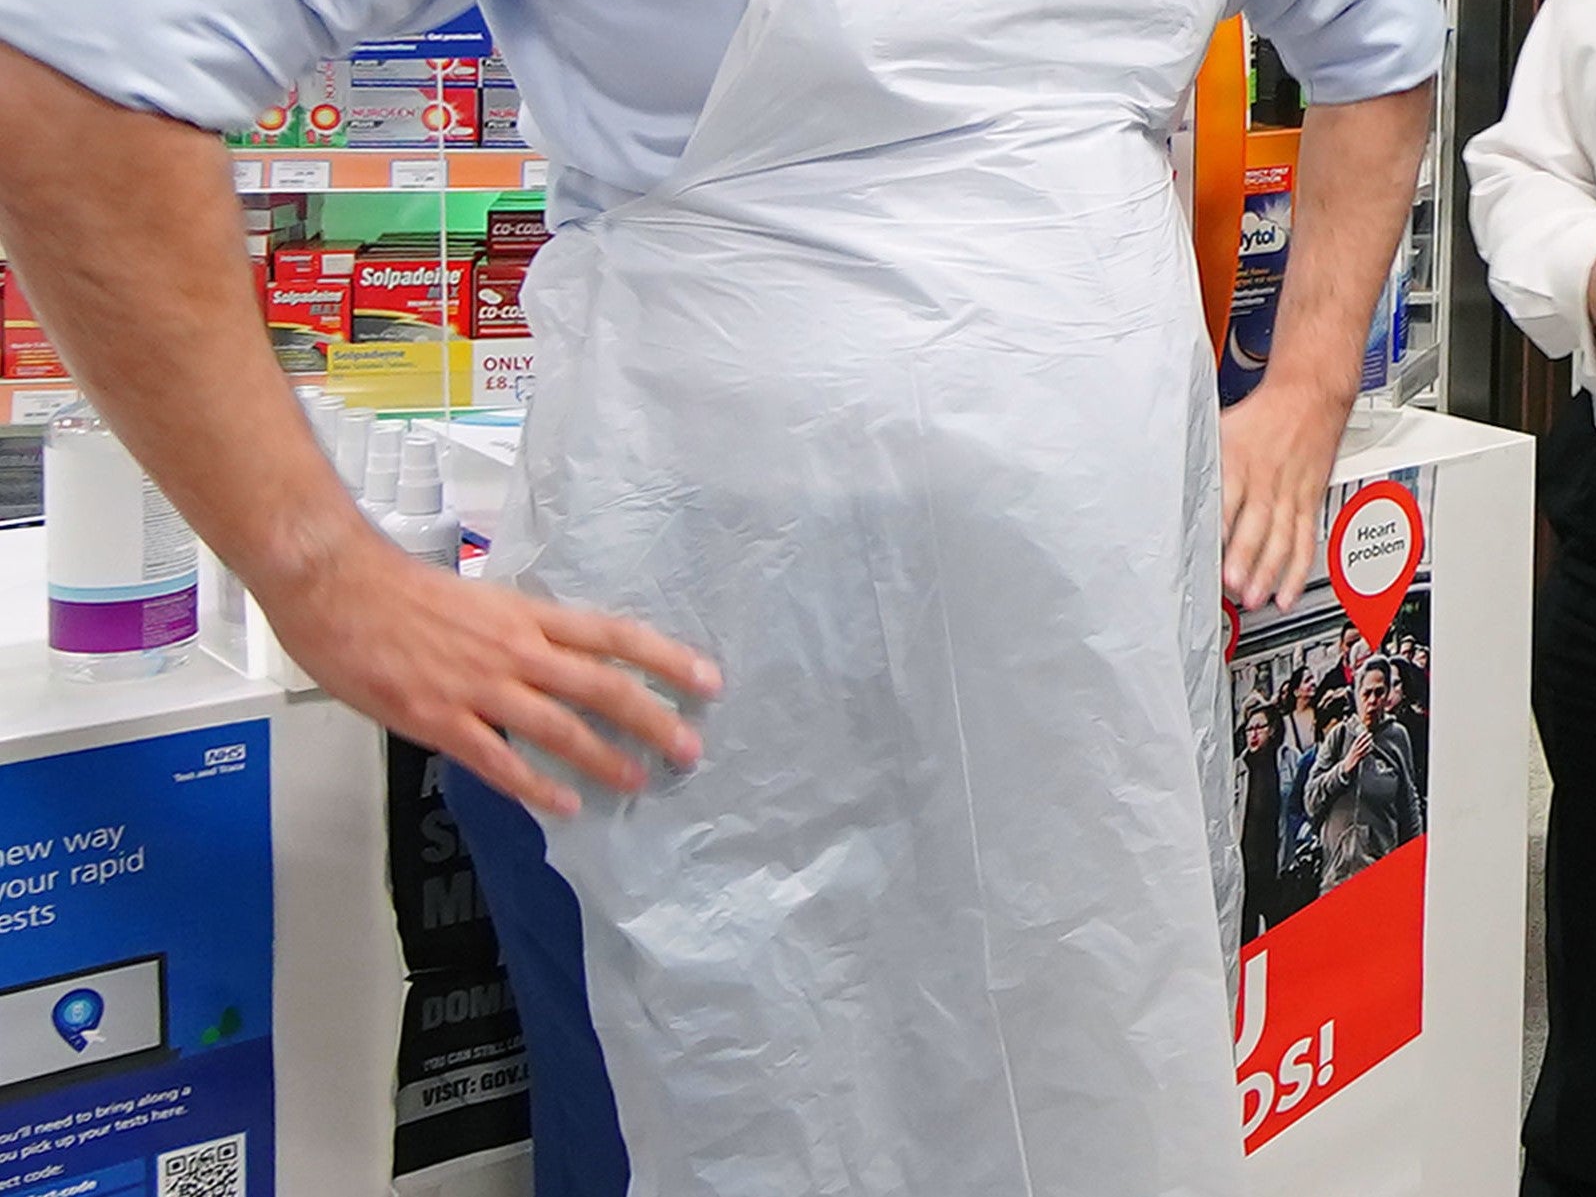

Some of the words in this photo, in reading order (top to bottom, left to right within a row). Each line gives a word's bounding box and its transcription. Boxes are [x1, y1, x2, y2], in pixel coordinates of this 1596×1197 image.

[352, 107, 416, 118] NUROFEN
[272, 290, 343, 306] Solpadeine
[484, 356, 533, 371] ONLY
[1357, 520, 1397, 542] Heart
[1347, 538, 1406, 568] problem
[0, 838, 53, 869] ew
[62, 823, 126, 852] way
[70, 845, 145, 885] rapid
[422, 1077, 477, 1107] VISIT:
[34, 1113, 74, 1135] need
[76, 1110, 94, 1124] to
[95, 1097, 136, 1119] bring
[137, 1088, 179, 1108] along
[181, 1085, 193, 1097] a
[20, 1139, 52, 1160] pick
[54, 1134, 77, 1149] up
[78, 1122, 113, 1146] your
[114, 1112, 149, 1132] tests
[151, 1104, 189, 1123] here.
[23, 1163, 65, 1184] code:
